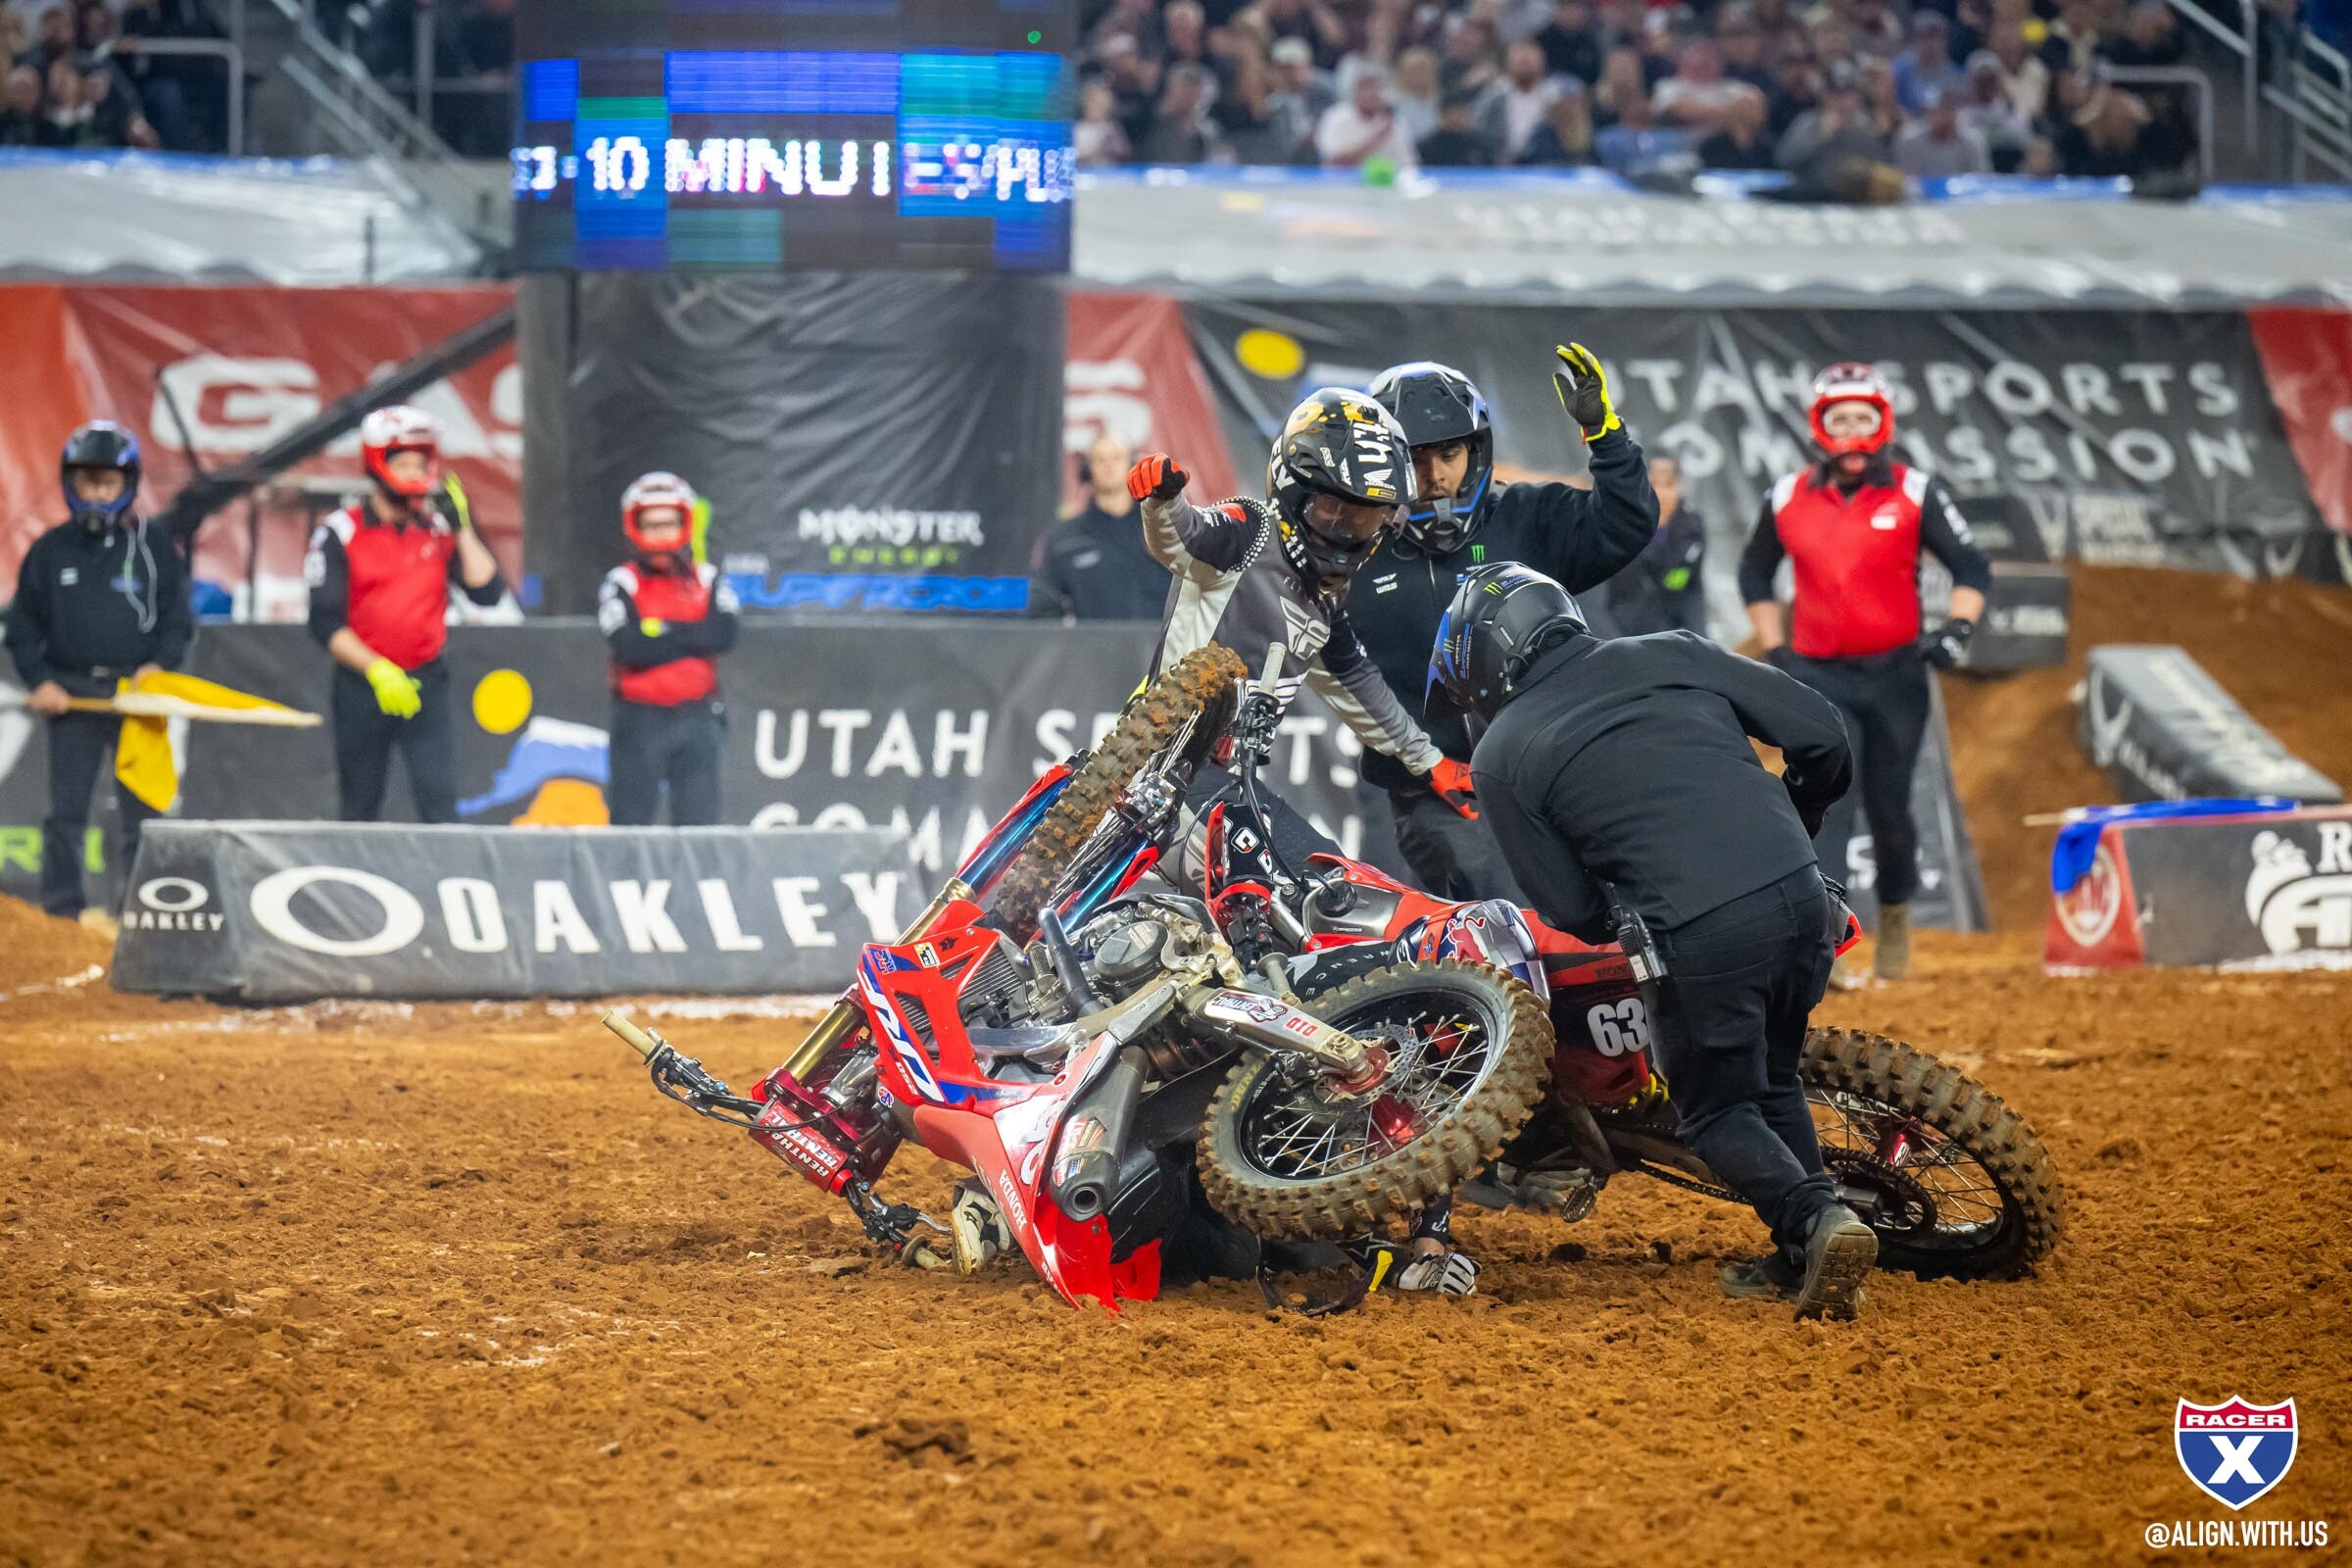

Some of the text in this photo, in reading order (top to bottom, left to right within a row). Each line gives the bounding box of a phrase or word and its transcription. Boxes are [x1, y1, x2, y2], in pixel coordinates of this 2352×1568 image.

[586, 136, 650, 192] 10
[799, 504, 984, 547] MONSTER
[755, 709, 989, 779] UTAH
[123, 910, 224, 931] OAKLEY
[437, 872, 906, 954] OAKLEY
[1587, 998, 1649, 1057] 63
[999, 1168, 1028, 1231] HONDA
